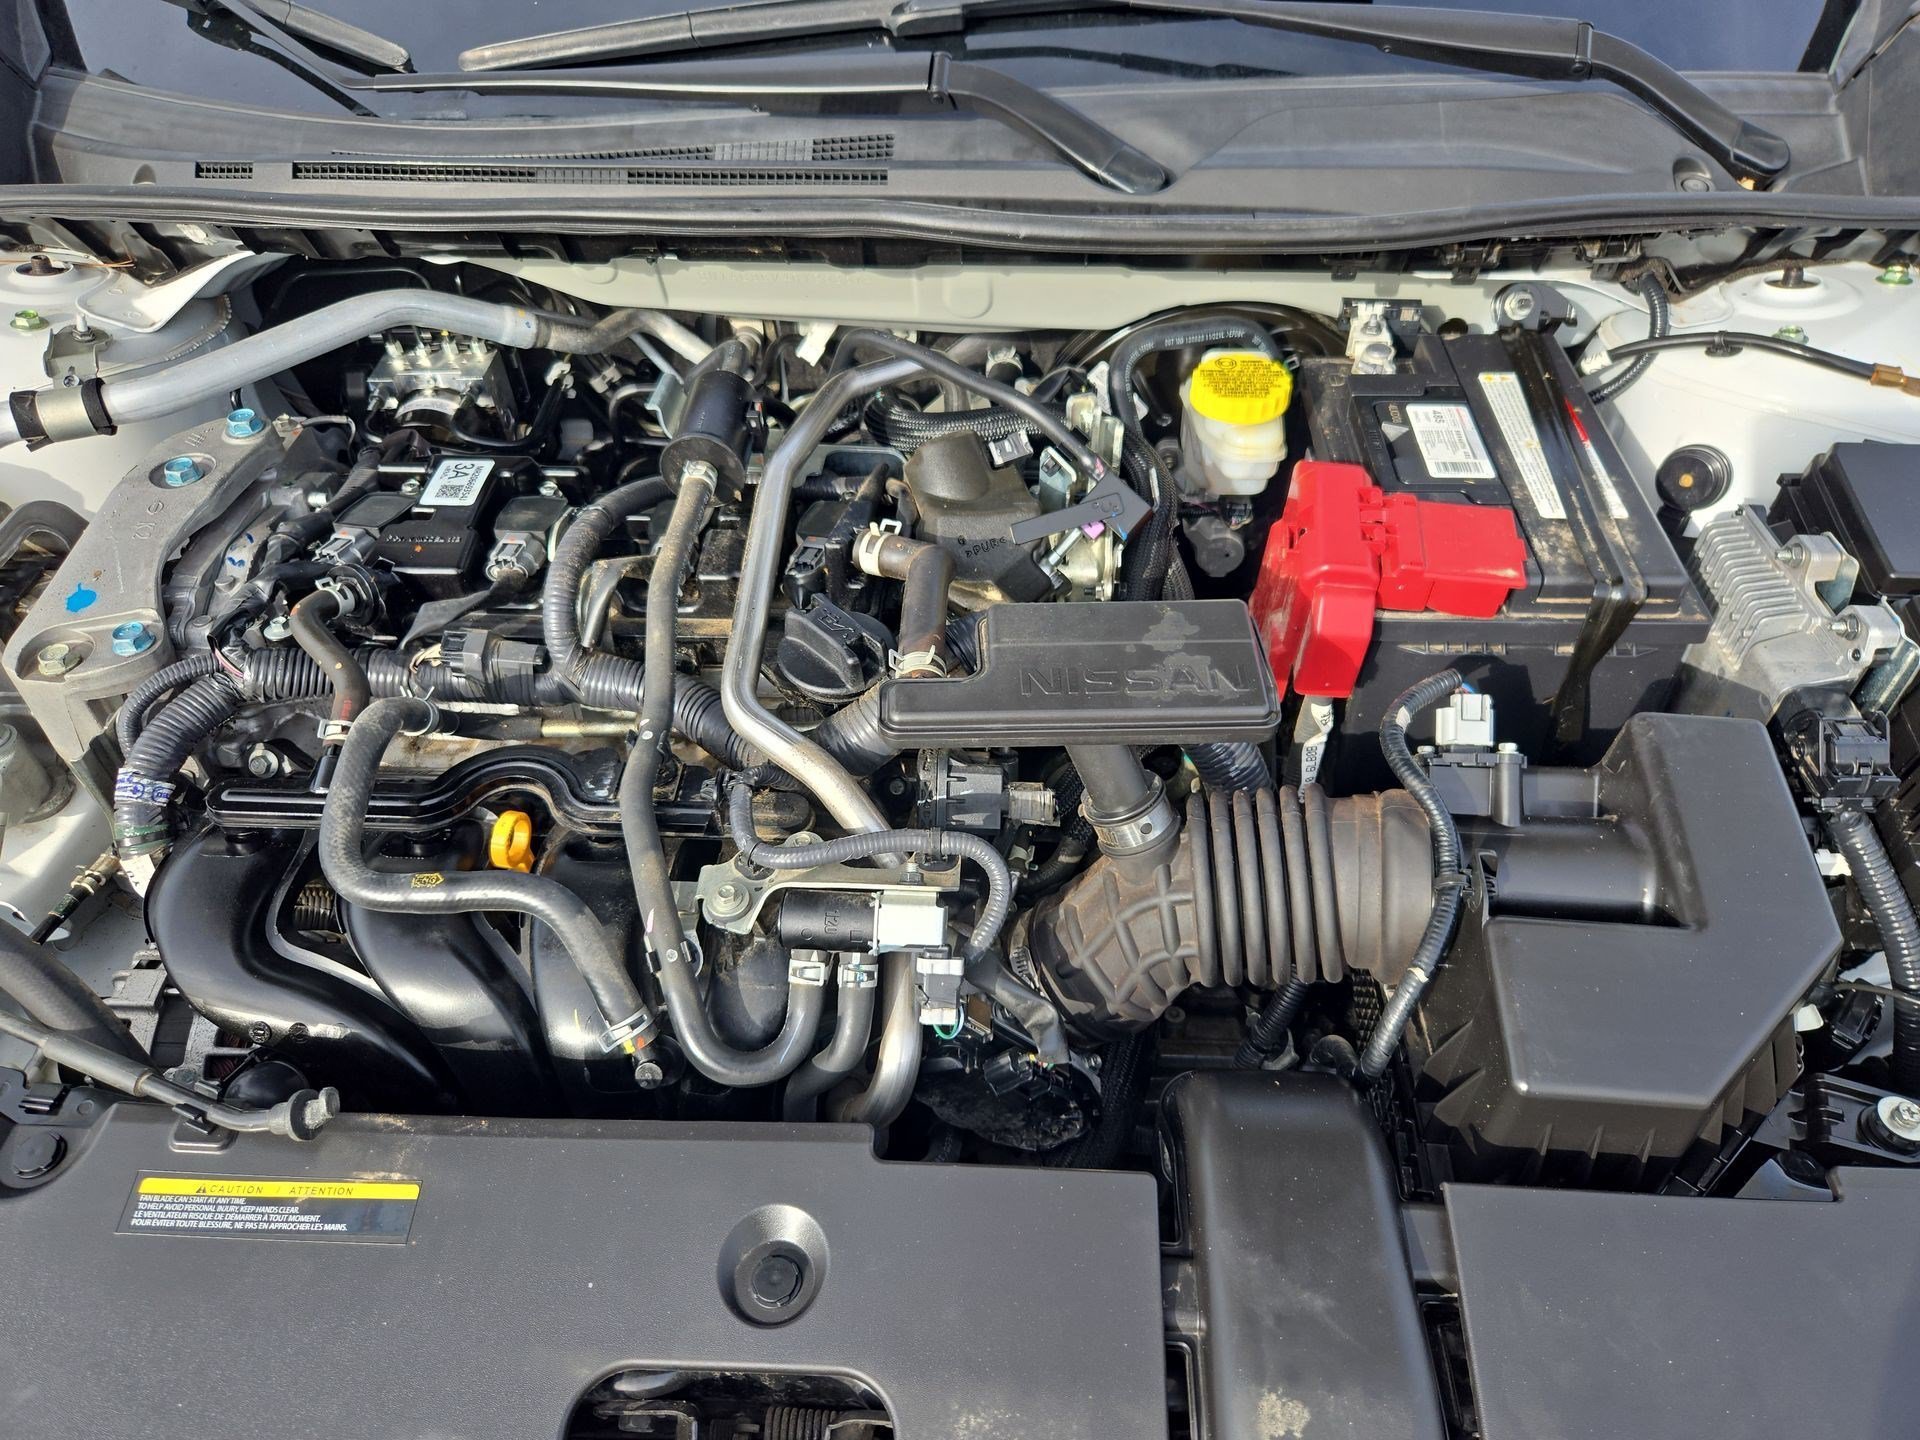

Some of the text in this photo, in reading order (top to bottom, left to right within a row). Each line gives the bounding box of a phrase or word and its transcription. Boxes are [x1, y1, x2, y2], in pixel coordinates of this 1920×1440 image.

[448, 463, 475, 479] 3A
[1018, 664, 1250, 696] NISSAN
[210, 1184, 264, 1194] CAUTION
[288, 1186, 354, 1196] ATTENTION
[140, 1194, 154, 1202] FAN
[138, 1202, 147, 1210] TO
[133, 1210, 143, 1218] LE
[143, 1211, 188, 1219] VENTILATEUR
[224, 1213, 262, 1221] DÉMARRER
[131, 1218, 152, 1226] POUR
[152, 1218, 175, 1227] ÉVITER
[198, 1221, 233, 1229] BLESSURE,
